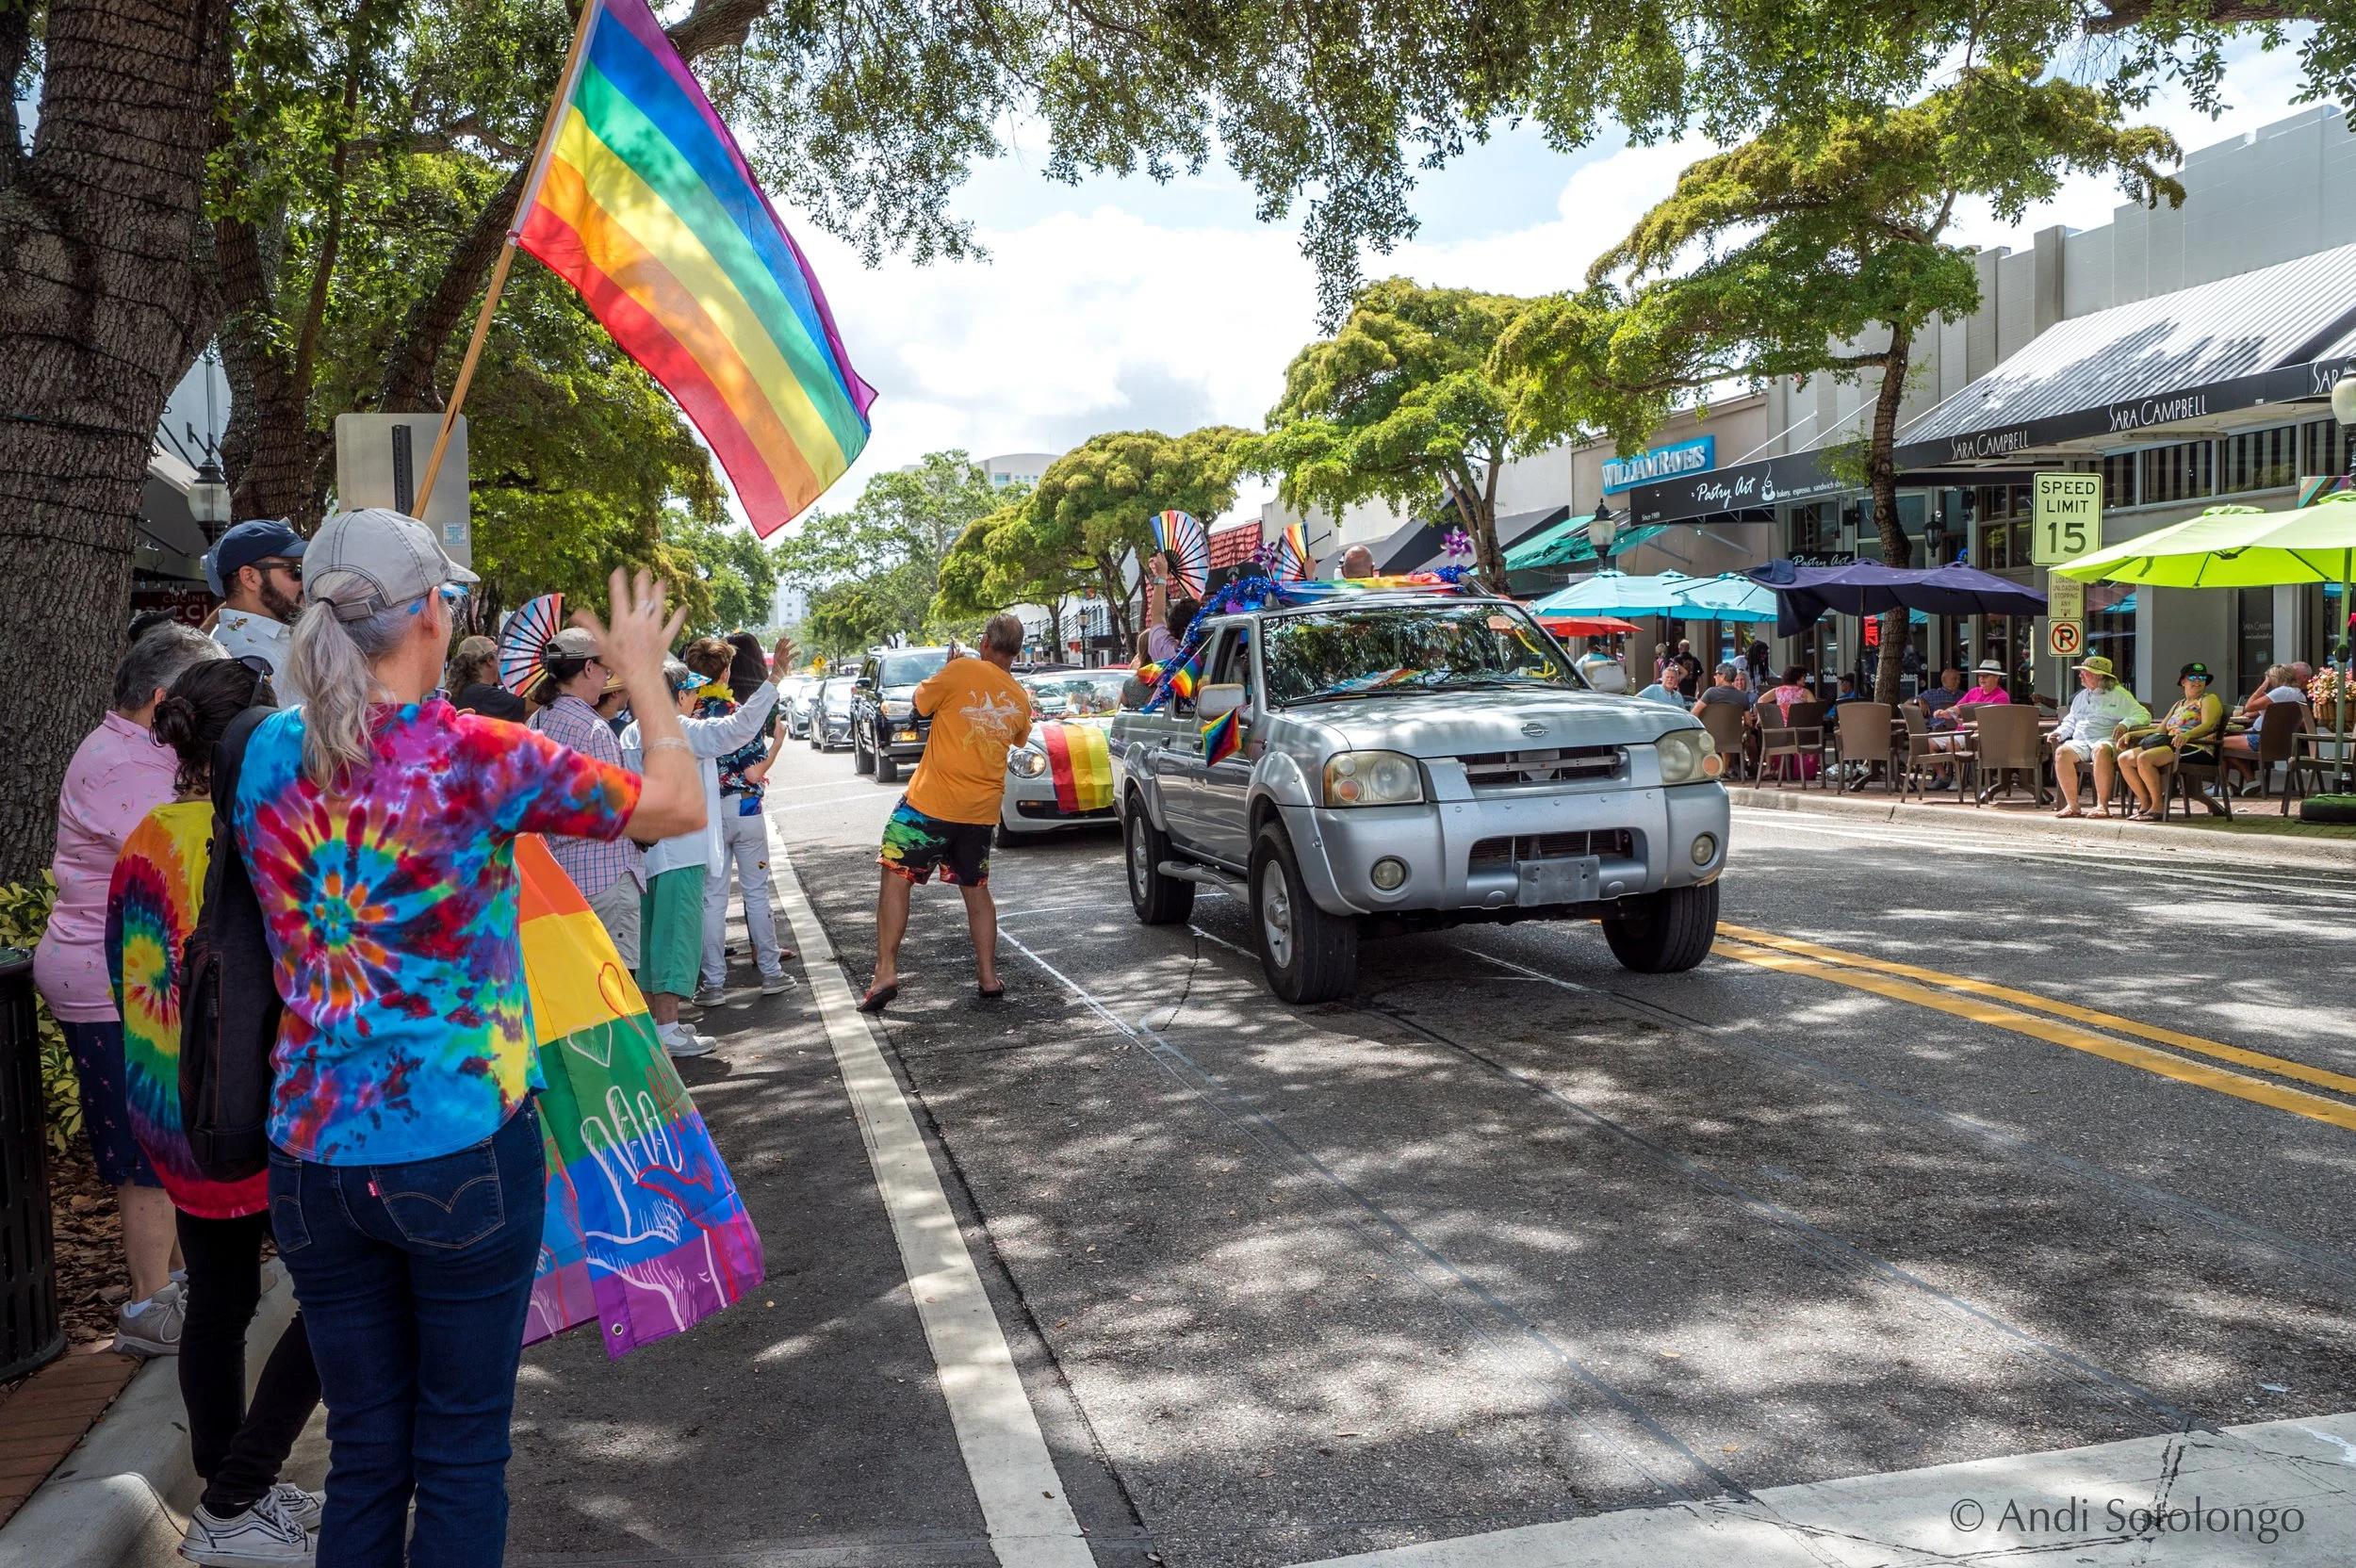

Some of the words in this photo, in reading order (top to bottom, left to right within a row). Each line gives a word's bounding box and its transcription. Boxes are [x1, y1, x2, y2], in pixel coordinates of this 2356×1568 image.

[2109, 402, 2139, 433] SARA
[2140, 394, 2207, 425] CAMPBELL
[1951, 434, 1975, 461] SARA
[1976, 430, 2029, 458] CAMPBELL
[1601, 455, 1659, 488] WILLIAM
[1658, 445, 1706, 475] RAVEIS
[1696, 482, 1732, 510] Pastry
[1735, 476, 1757, 497] Art
[2041, 481, 2096, 495] SPEED
[2047, 500, 2089, 514] LIMIT
[2048, 521, 2086, 554] 15
[1831, 554, 1850, 565] Art
[162, 595, 208, 603] CUCINE
